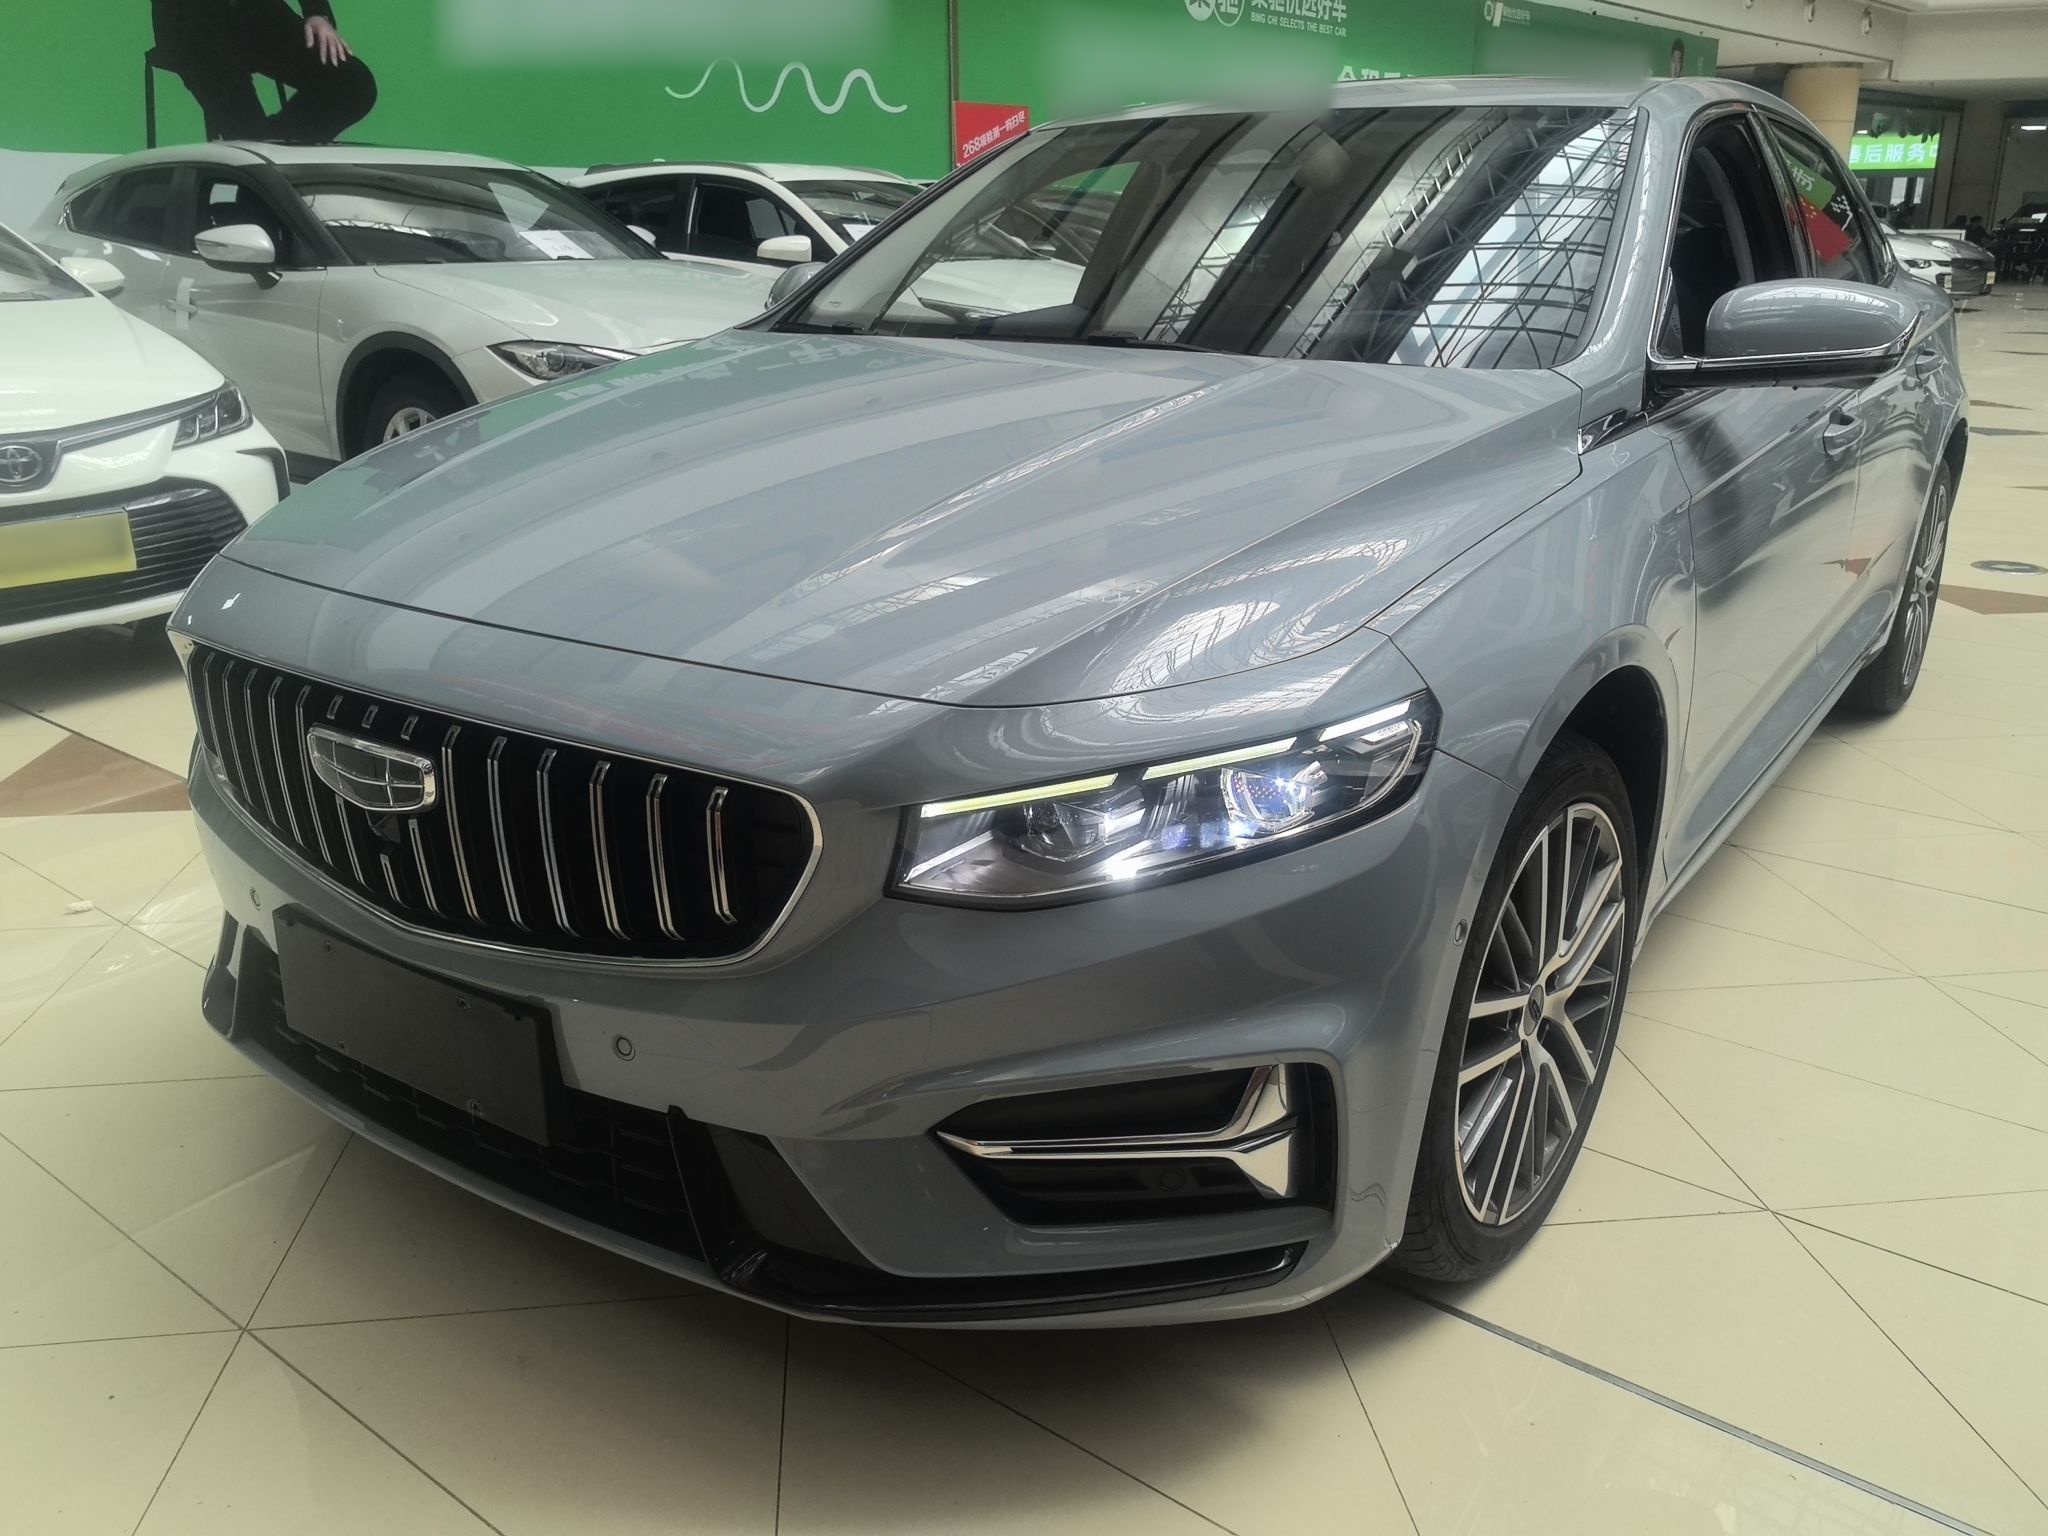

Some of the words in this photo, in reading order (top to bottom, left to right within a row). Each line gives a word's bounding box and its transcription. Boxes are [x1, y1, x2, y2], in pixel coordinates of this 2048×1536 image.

[1251, 12, 1266, 24] BING
[1267, 15, 1278, 26] CHI
[1279, 17, 1305, 31] SELECTS
[1306, 21, 1318, 33] THE
[1319, 24, 1333, 35] BEST
[1334, 26, 1347, 37] CAR
